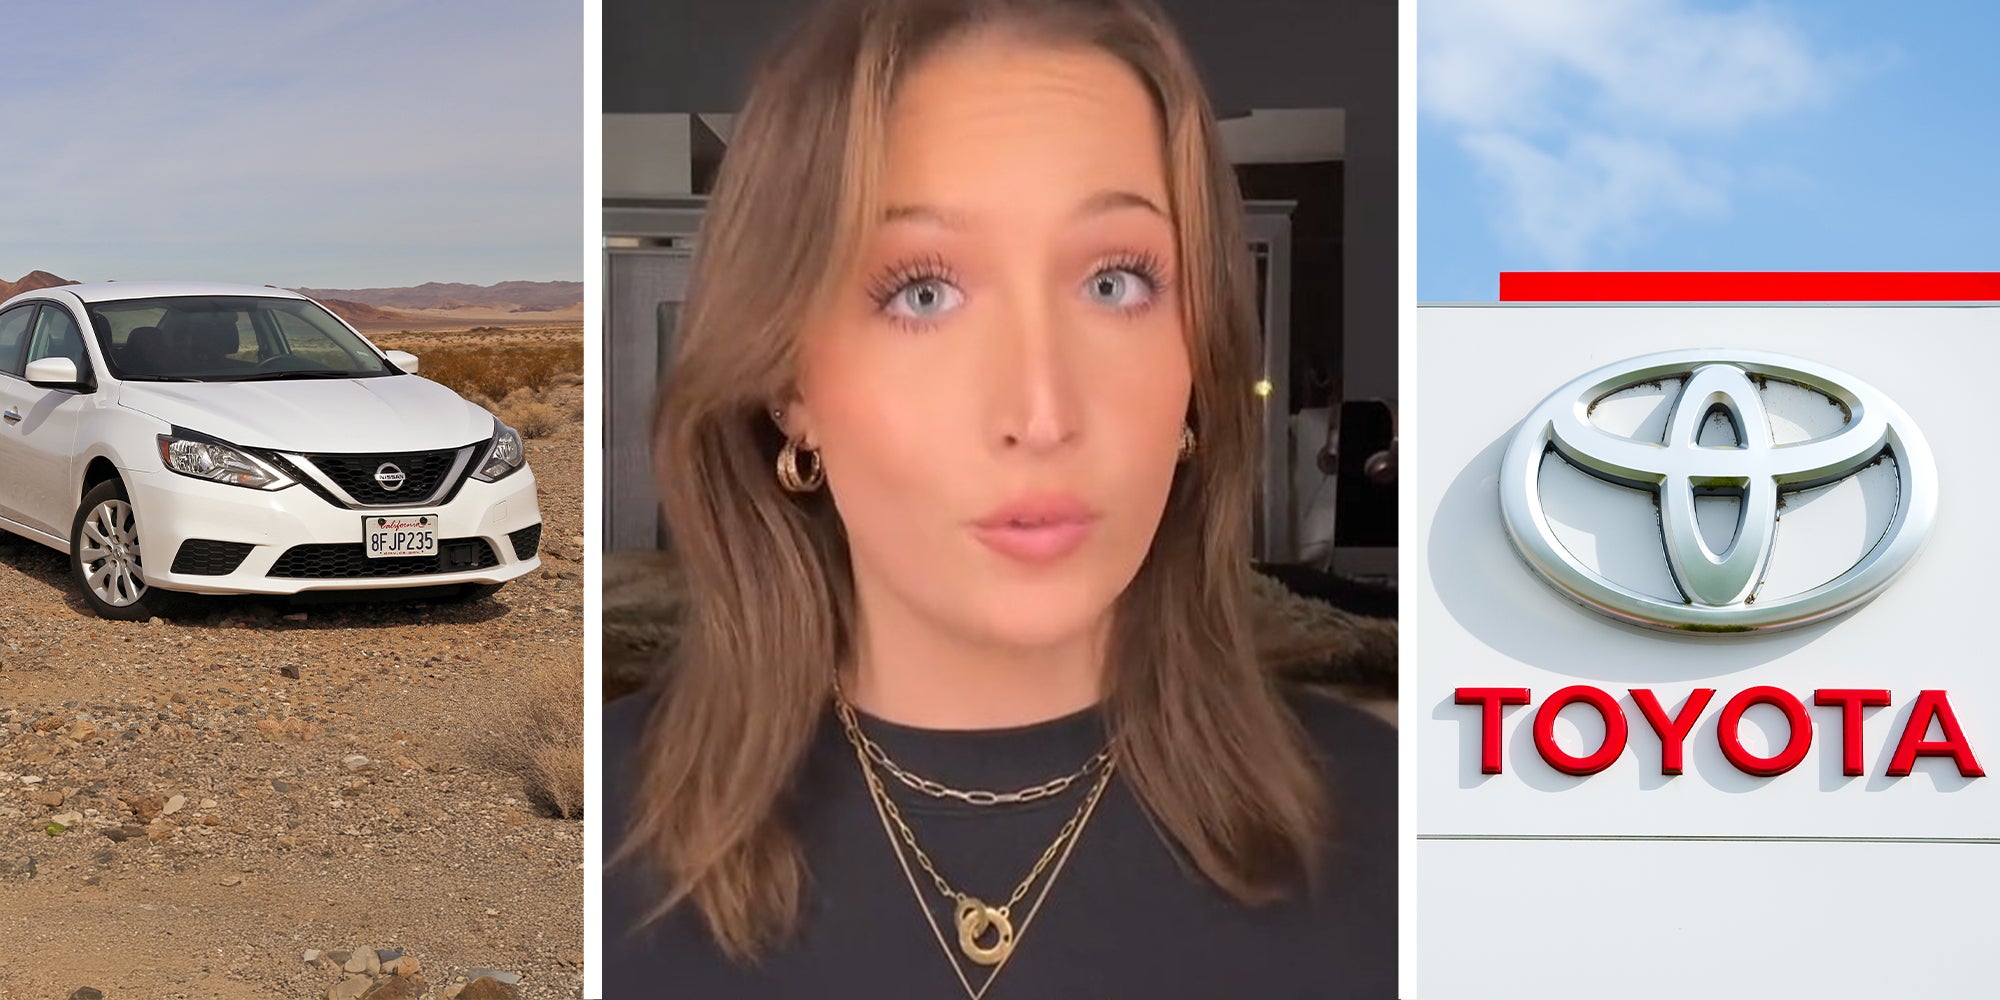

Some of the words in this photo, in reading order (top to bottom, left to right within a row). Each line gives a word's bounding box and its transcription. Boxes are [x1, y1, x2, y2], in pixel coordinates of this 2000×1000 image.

[380, 519, 424, 531] California
[371, 531, 433, 552] 8FJP235
[1454, 685, 1986, 778] TOYOTA
